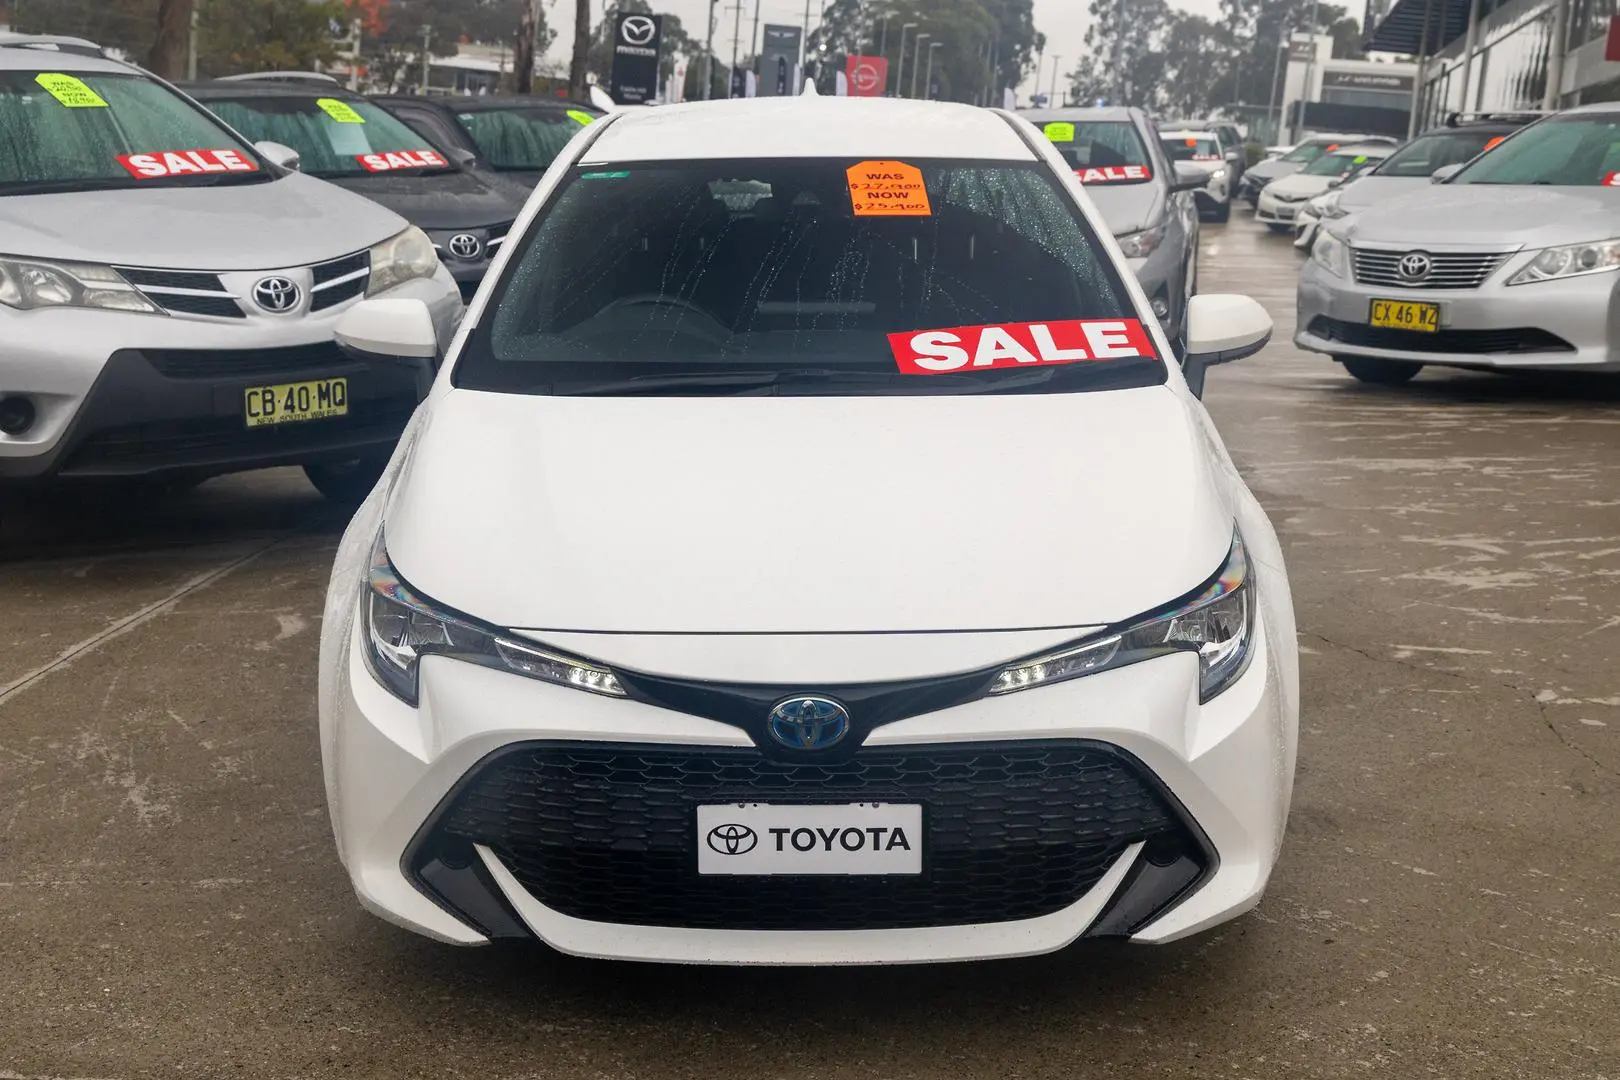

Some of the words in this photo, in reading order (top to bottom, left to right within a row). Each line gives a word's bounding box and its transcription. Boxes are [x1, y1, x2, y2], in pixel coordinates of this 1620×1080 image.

[128, 150, 251, 176] SALE
[363, 151, 444, 170] SALE
[909, 321, 1140, 371] SALE
[769, 827, 911, 852] TOYOTA
